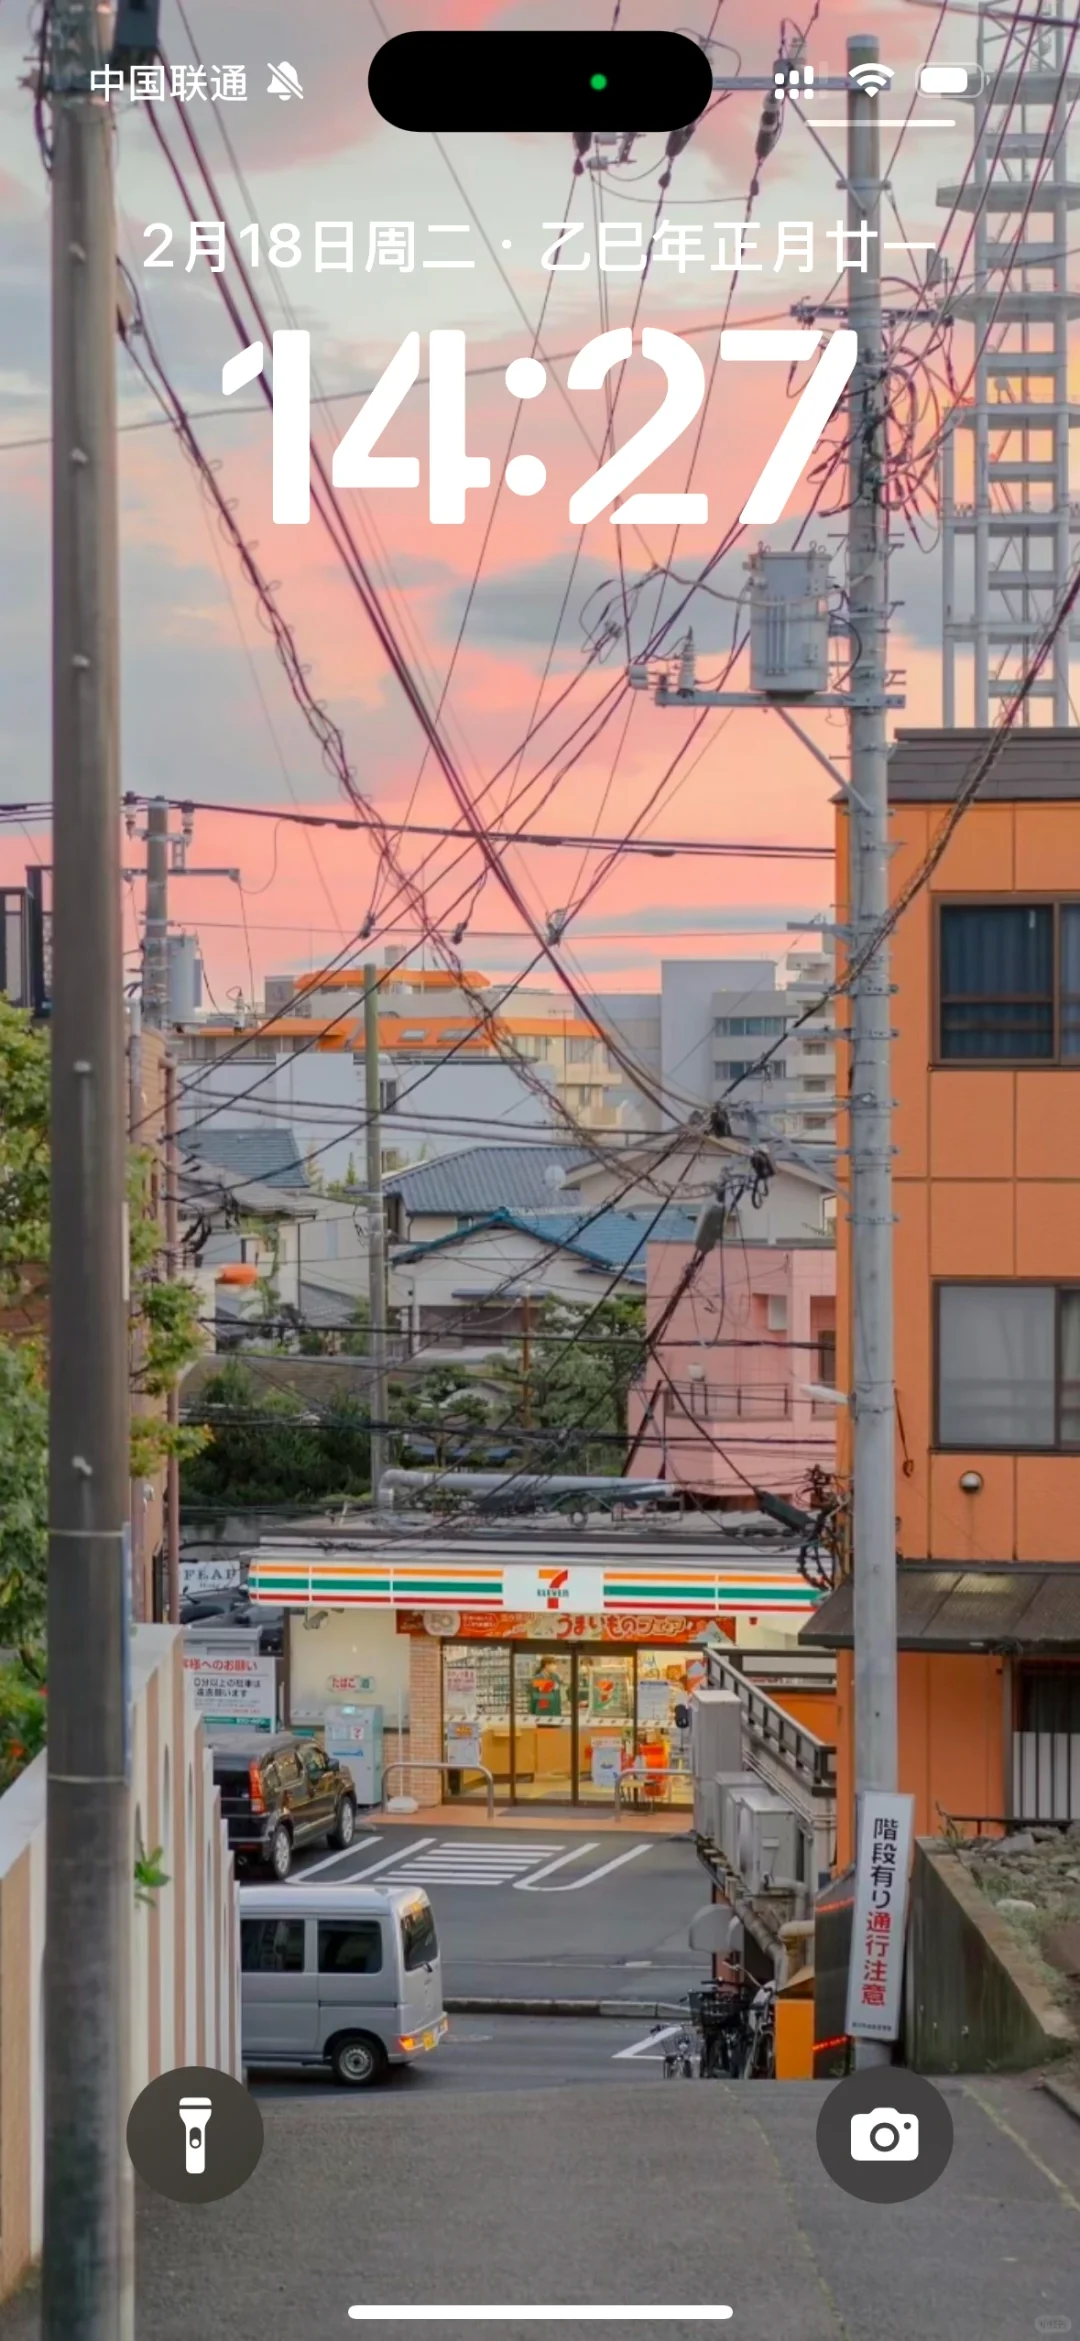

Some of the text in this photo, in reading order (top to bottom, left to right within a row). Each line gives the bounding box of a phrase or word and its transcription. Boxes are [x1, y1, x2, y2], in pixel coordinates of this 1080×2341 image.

[861, 1817, 898, 2007] 階段有り通行注意
